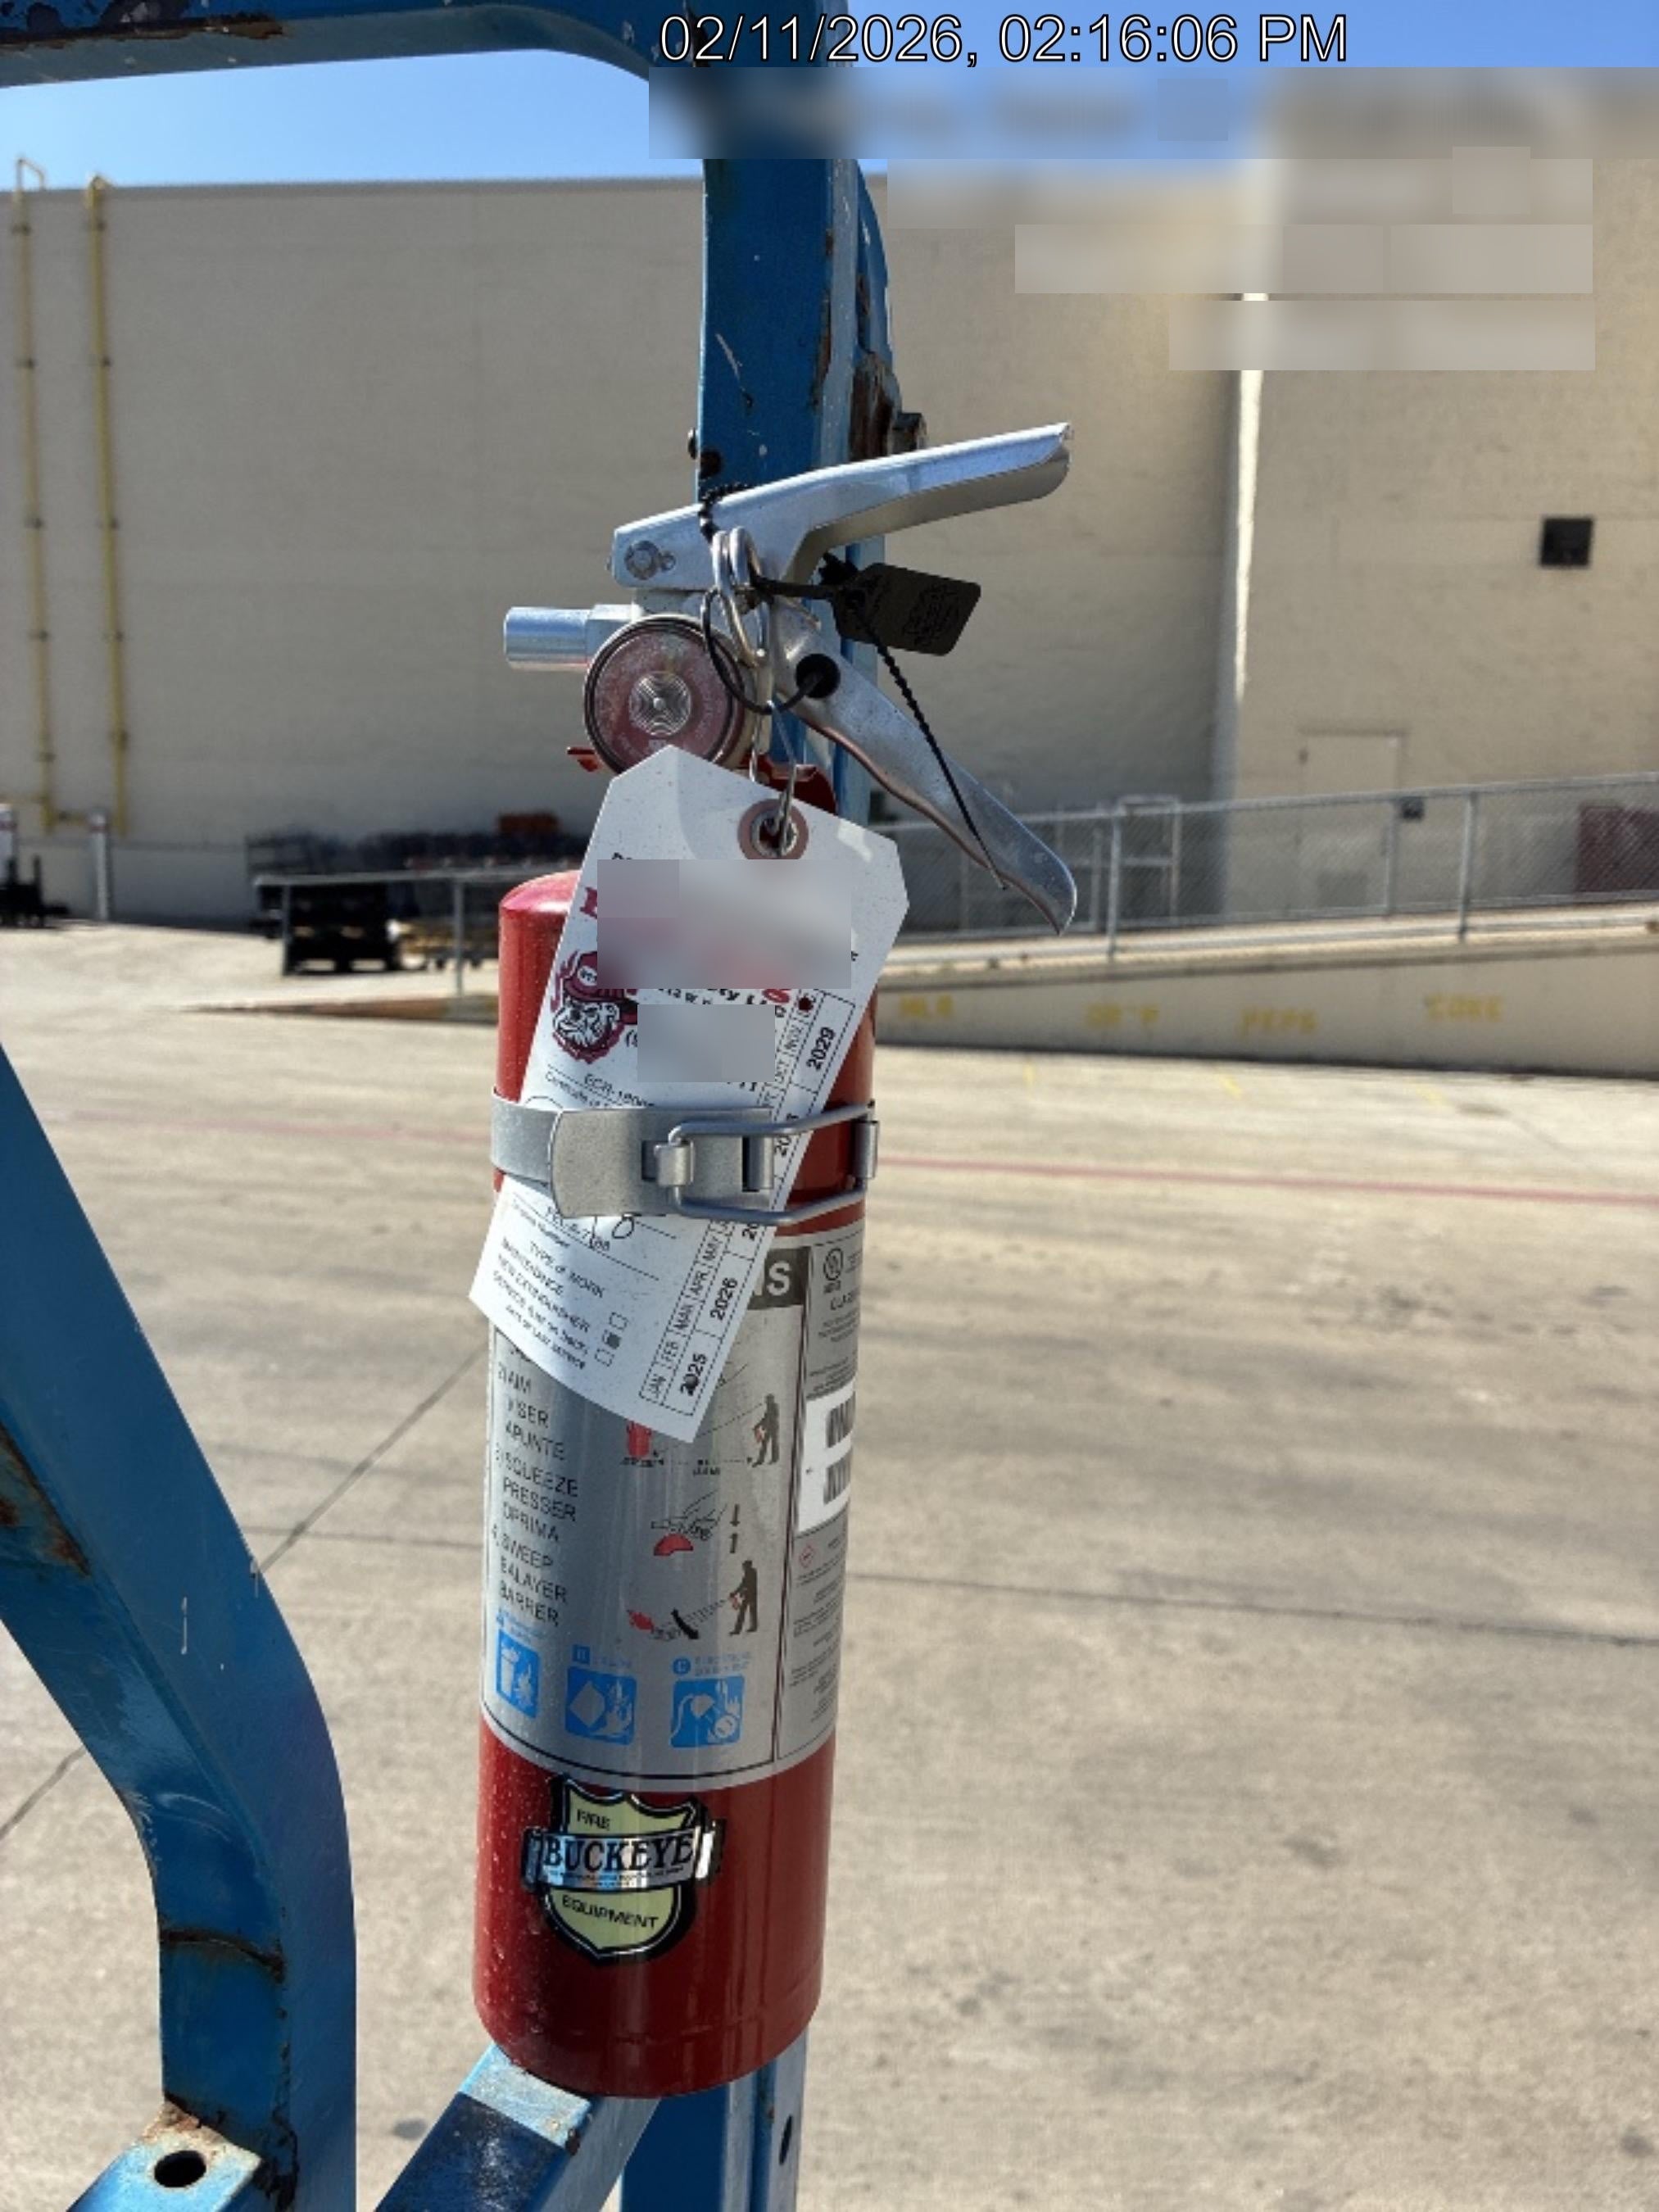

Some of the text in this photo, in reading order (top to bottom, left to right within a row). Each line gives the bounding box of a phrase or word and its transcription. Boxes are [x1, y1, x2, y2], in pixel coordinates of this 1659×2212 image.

[807, 1027, 835, 1071] 2029
[691, 1270, 709, 1295] APR
[710, 1278, 737, 1321] 2026
[661, 1341, 679, 1362] FEB
[503, 1477, 576, 1522] PRESSER
[501, 1556, 569, 1603] BALAYER
[499, 1580, 560, 1627] BARRER
[576, 1808, 610, 1831] FIRE
[543, 1834, 694, 1872] BUCKEYE
[562, 1894, 659, 1928] EQUIPMENT
